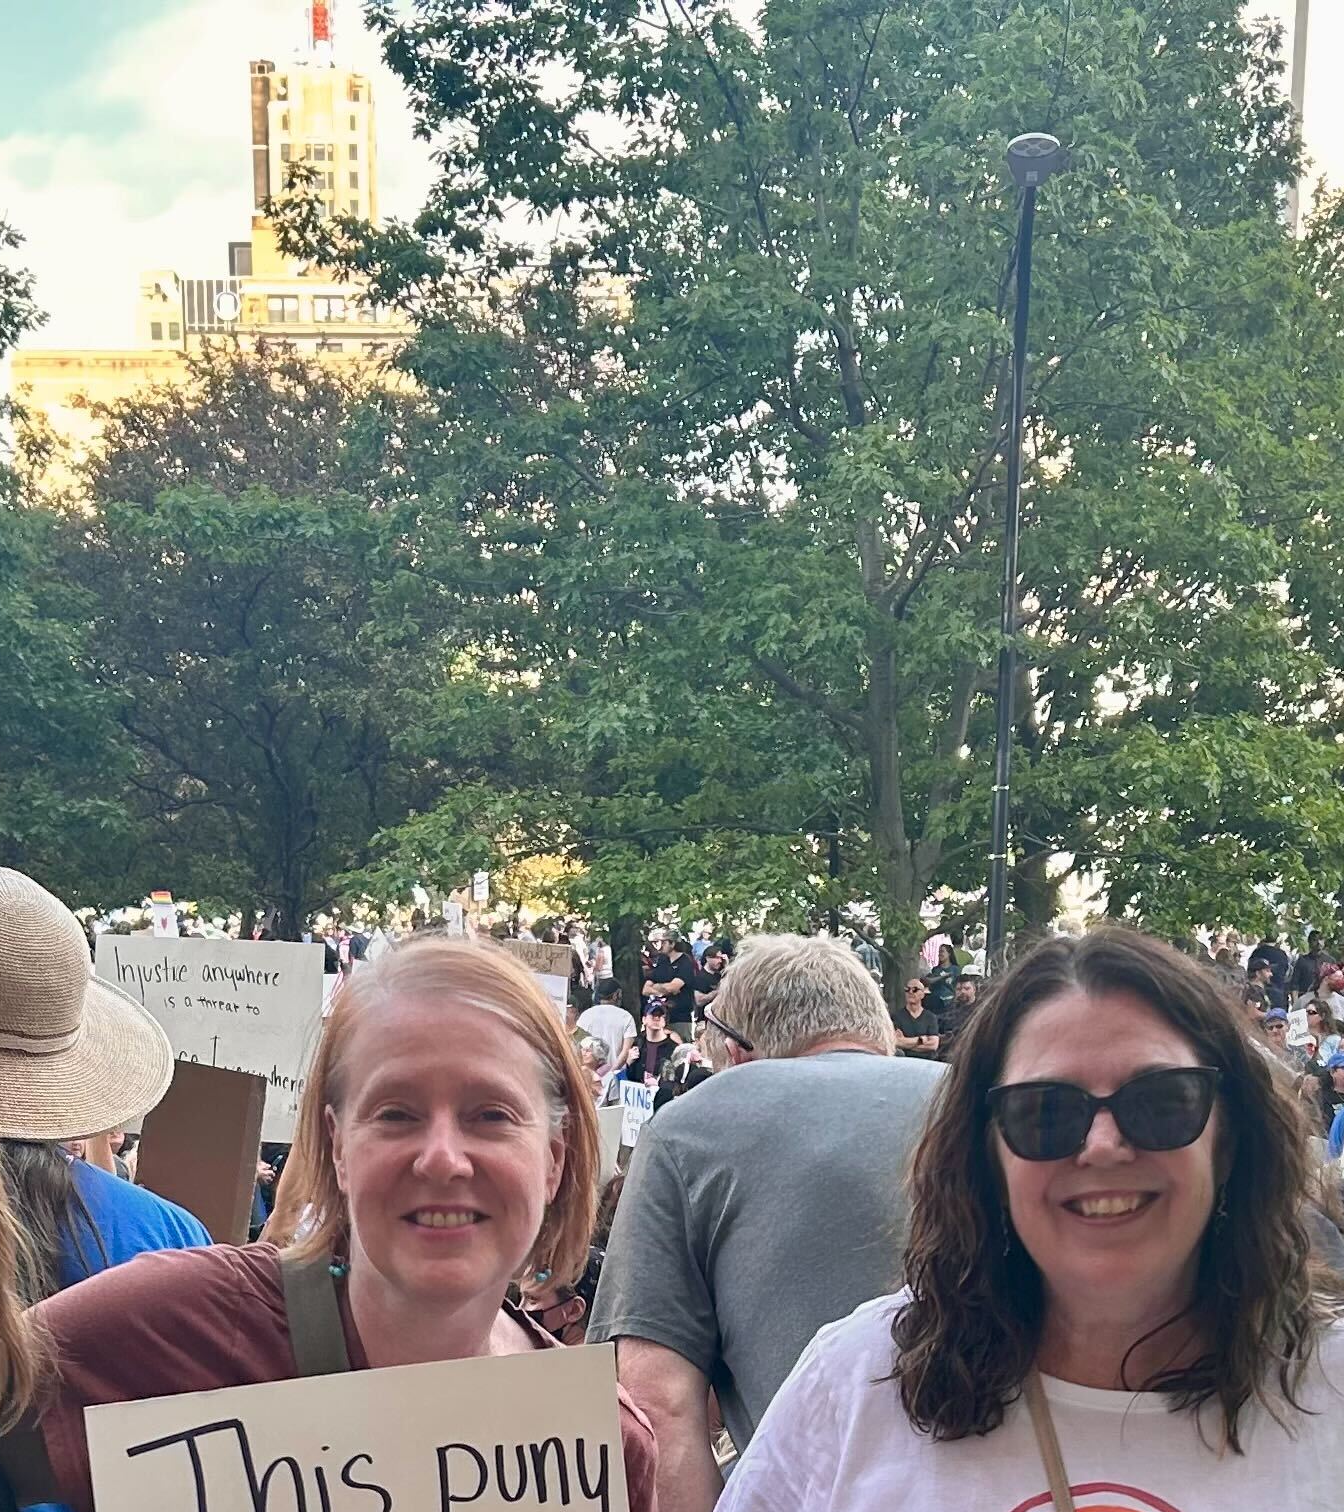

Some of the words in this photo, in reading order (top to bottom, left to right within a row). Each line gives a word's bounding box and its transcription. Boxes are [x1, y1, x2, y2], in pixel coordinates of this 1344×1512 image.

[202, 963, 281, 992] anywhere
[164, 996, 176, 1009] is
[184, 997, 193, 1008] a
[246, 1004, 261, 1016] to
